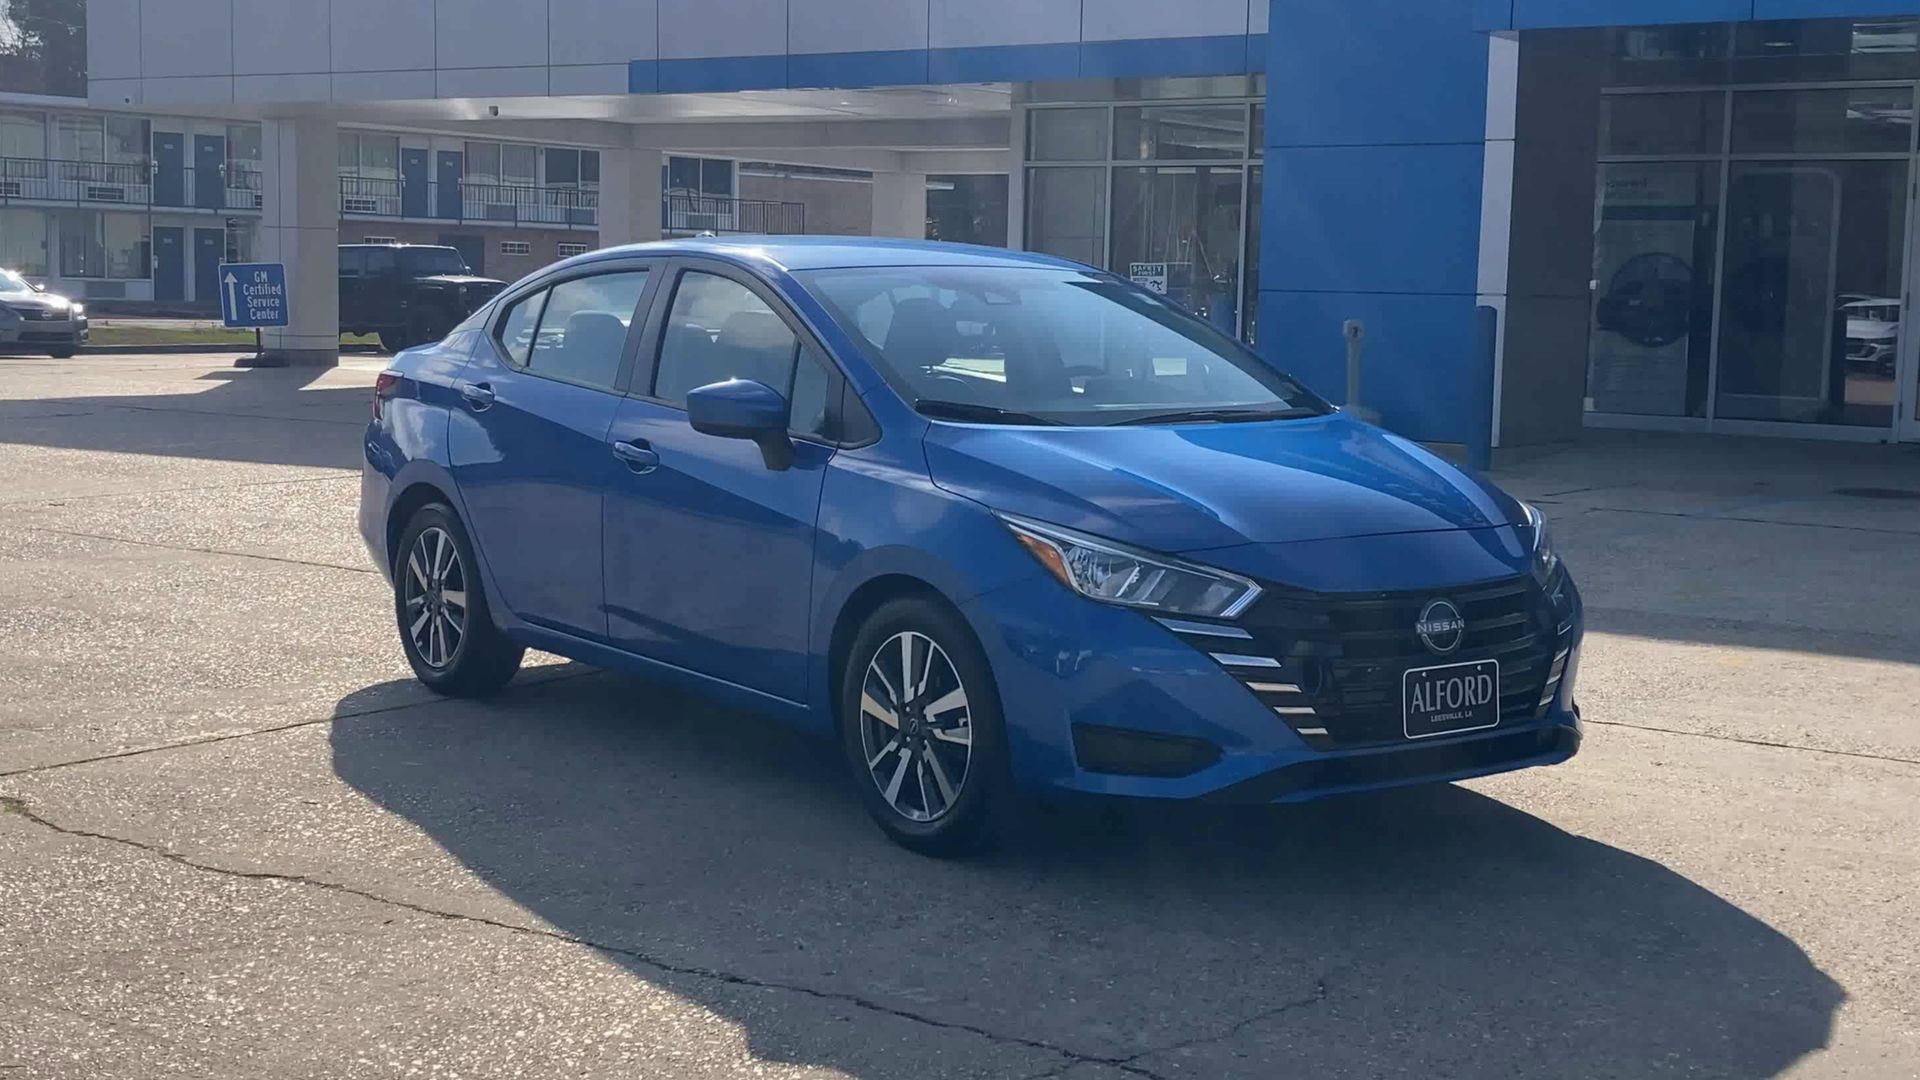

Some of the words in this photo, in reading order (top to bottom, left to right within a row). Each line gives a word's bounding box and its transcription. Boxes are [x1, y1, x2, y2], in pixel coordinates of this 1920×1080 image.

[254, 271, 268, 283] GM
[243, 283, 282, 295] Certified
[247, 296, 280, 308] Service
[250, 307, 279, 320] Center
[1416, 618, 1465, 634] NISSAN
[1411, 674, 1493, 714] ALFORD
[1464, 710, 1473, 718] LA
